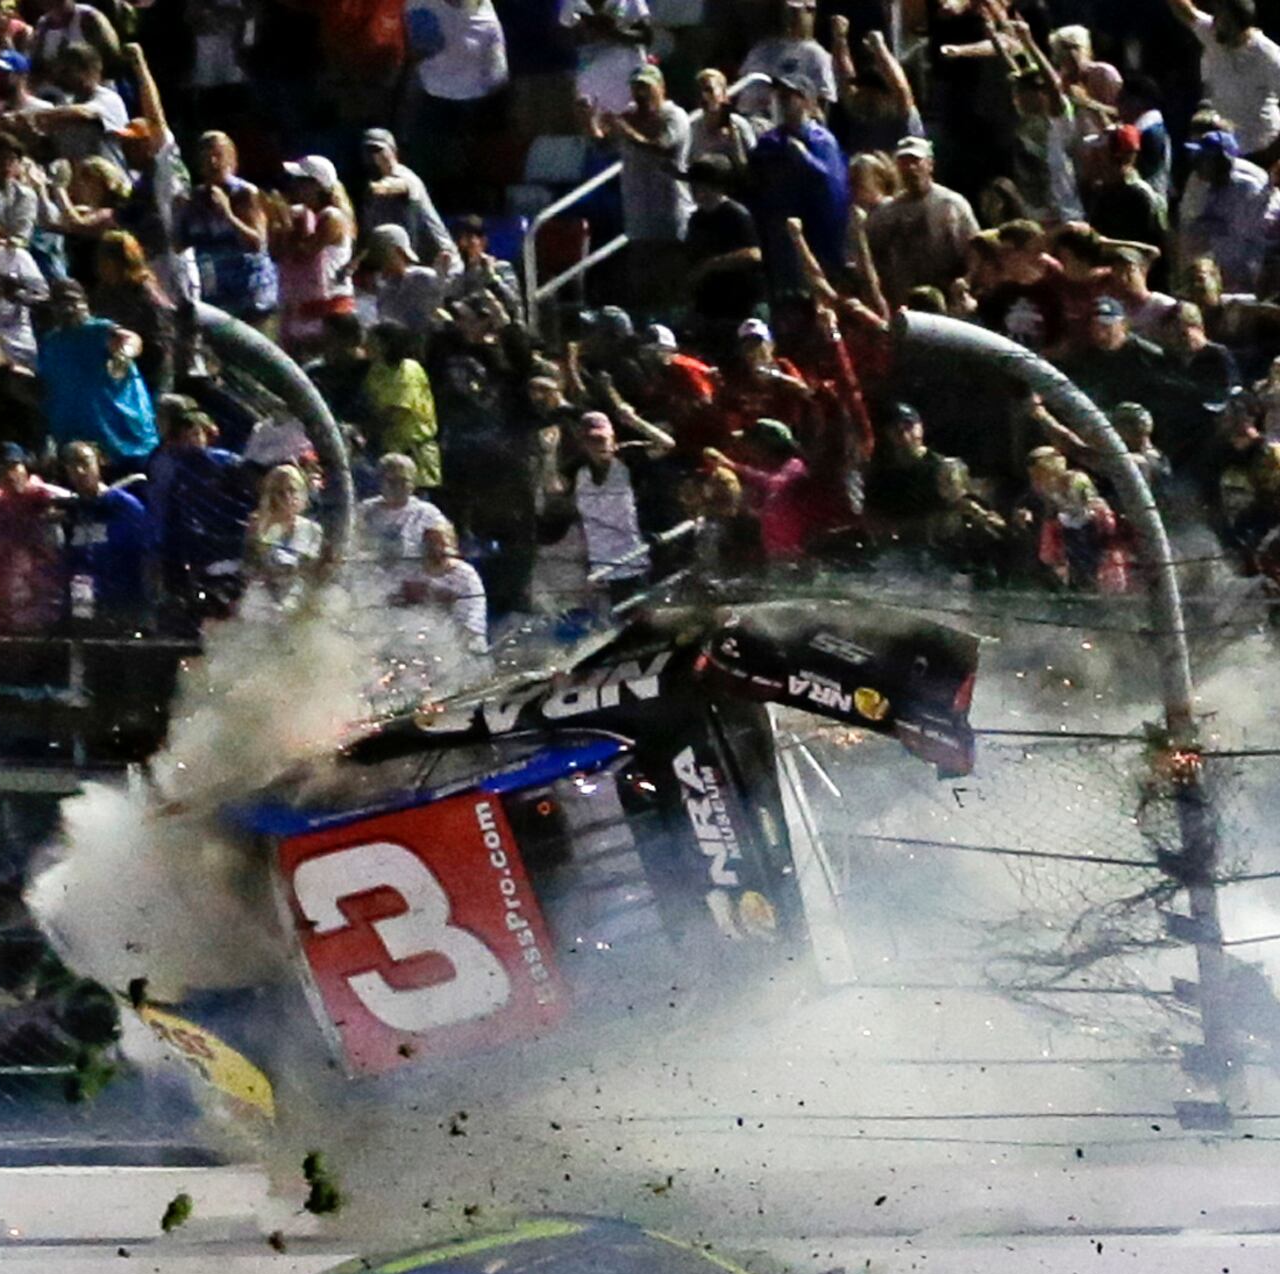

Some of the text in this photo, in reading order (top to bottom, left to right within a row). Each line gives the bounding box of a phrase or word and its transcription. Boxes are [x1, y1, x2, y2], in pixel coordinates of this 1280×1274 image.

[787, 673, 853, 713] NRA
[672, 745, 740, 887] NRA
[293, 841, 511, 1032] 3
